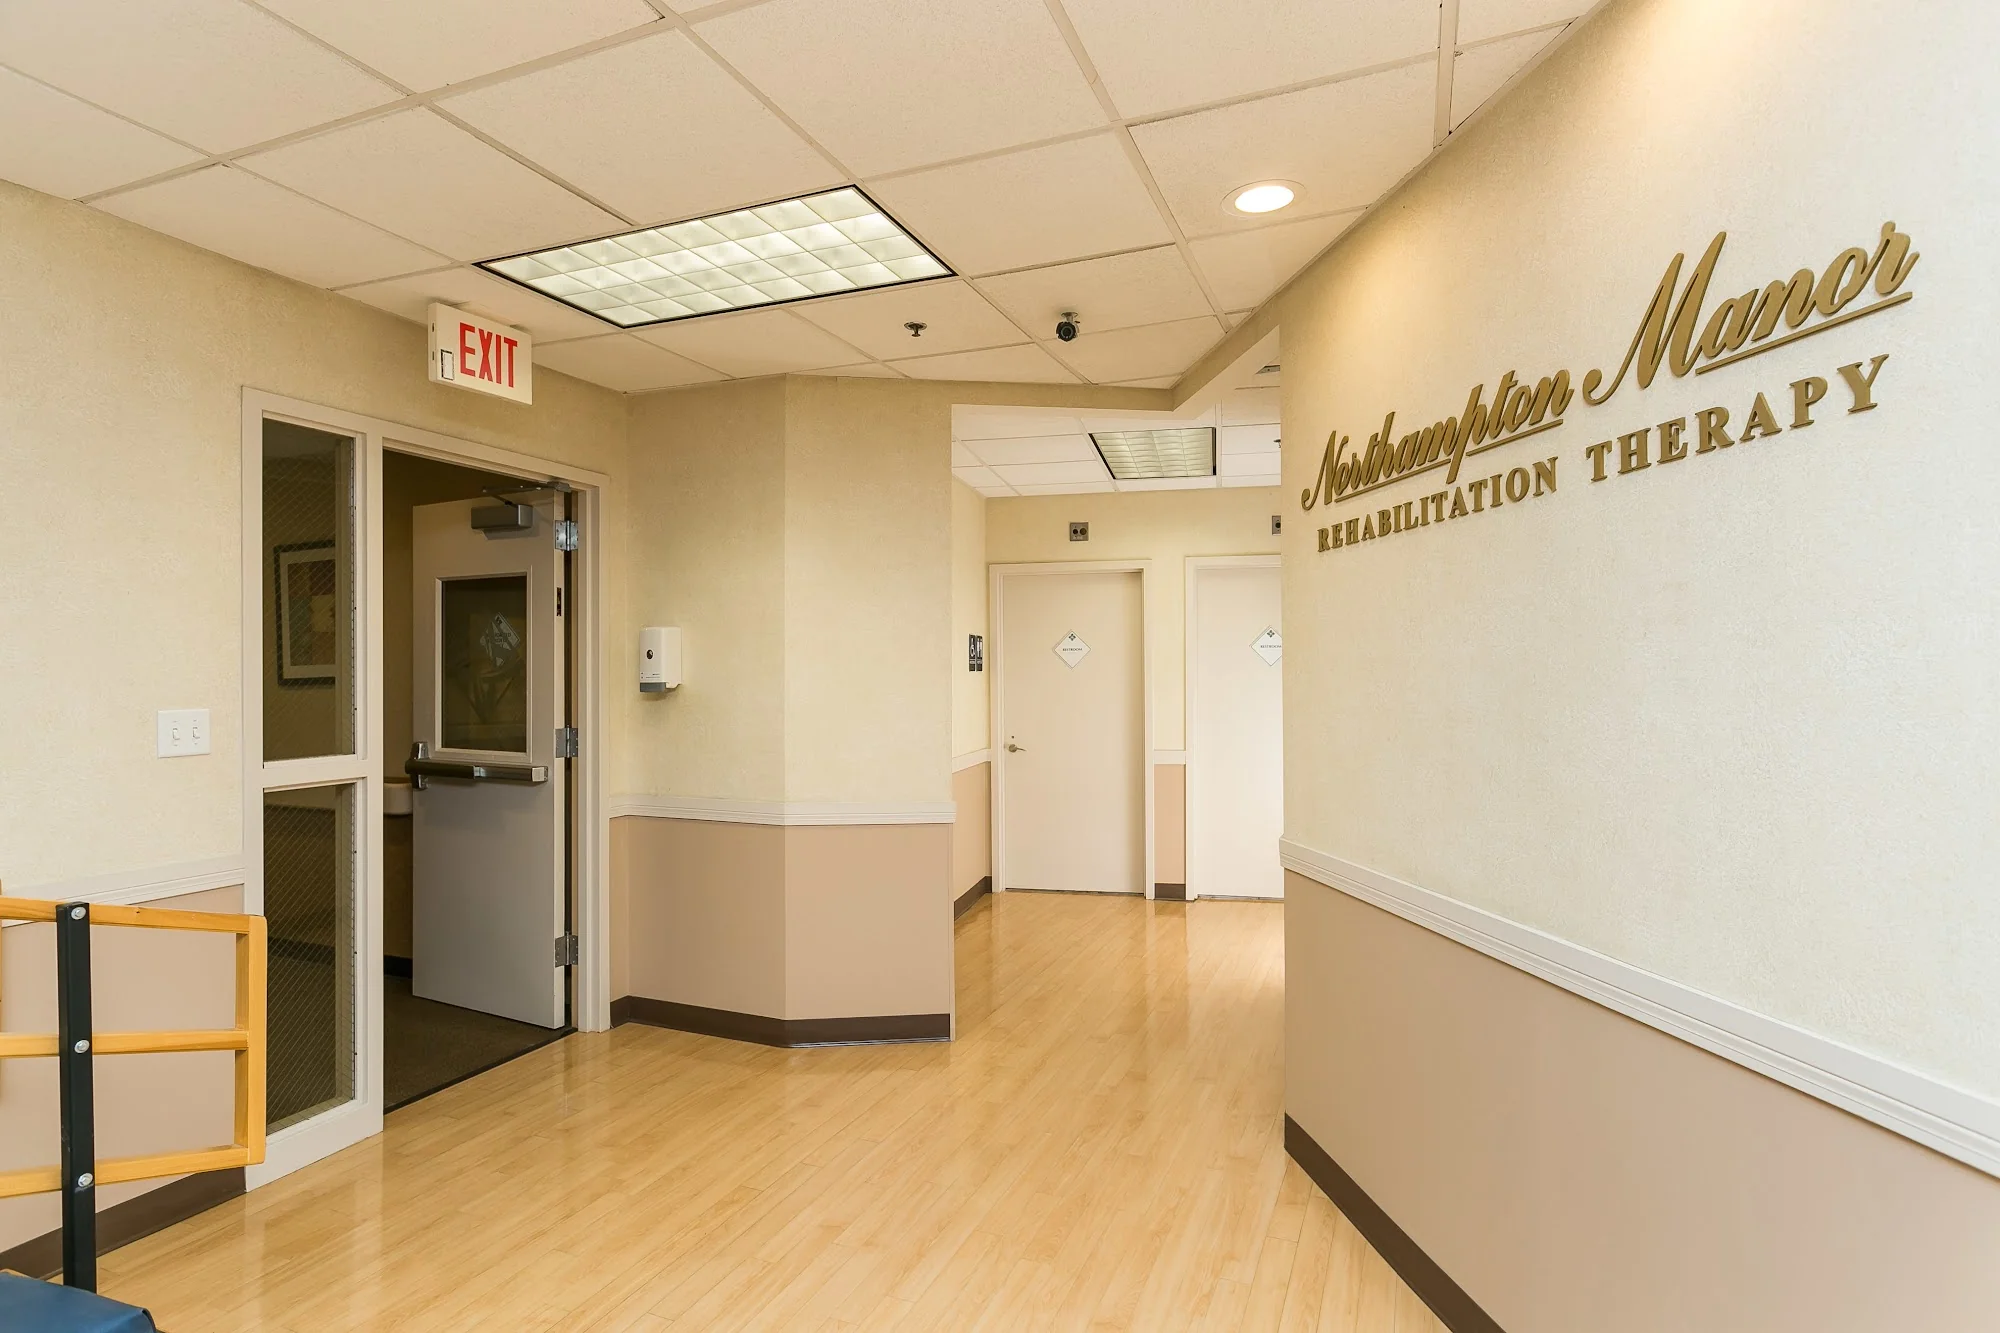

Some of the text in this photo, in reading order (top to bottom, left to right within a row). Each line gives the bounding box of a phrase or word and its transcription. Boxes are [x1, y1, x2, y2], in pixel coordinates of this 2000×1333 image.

[459, 321, 518, 388] EXIT
[1301, 221, 1920, 511] Northampton Manor
[1317, 353, 1890, 553] REHABILITATION THERAPY
